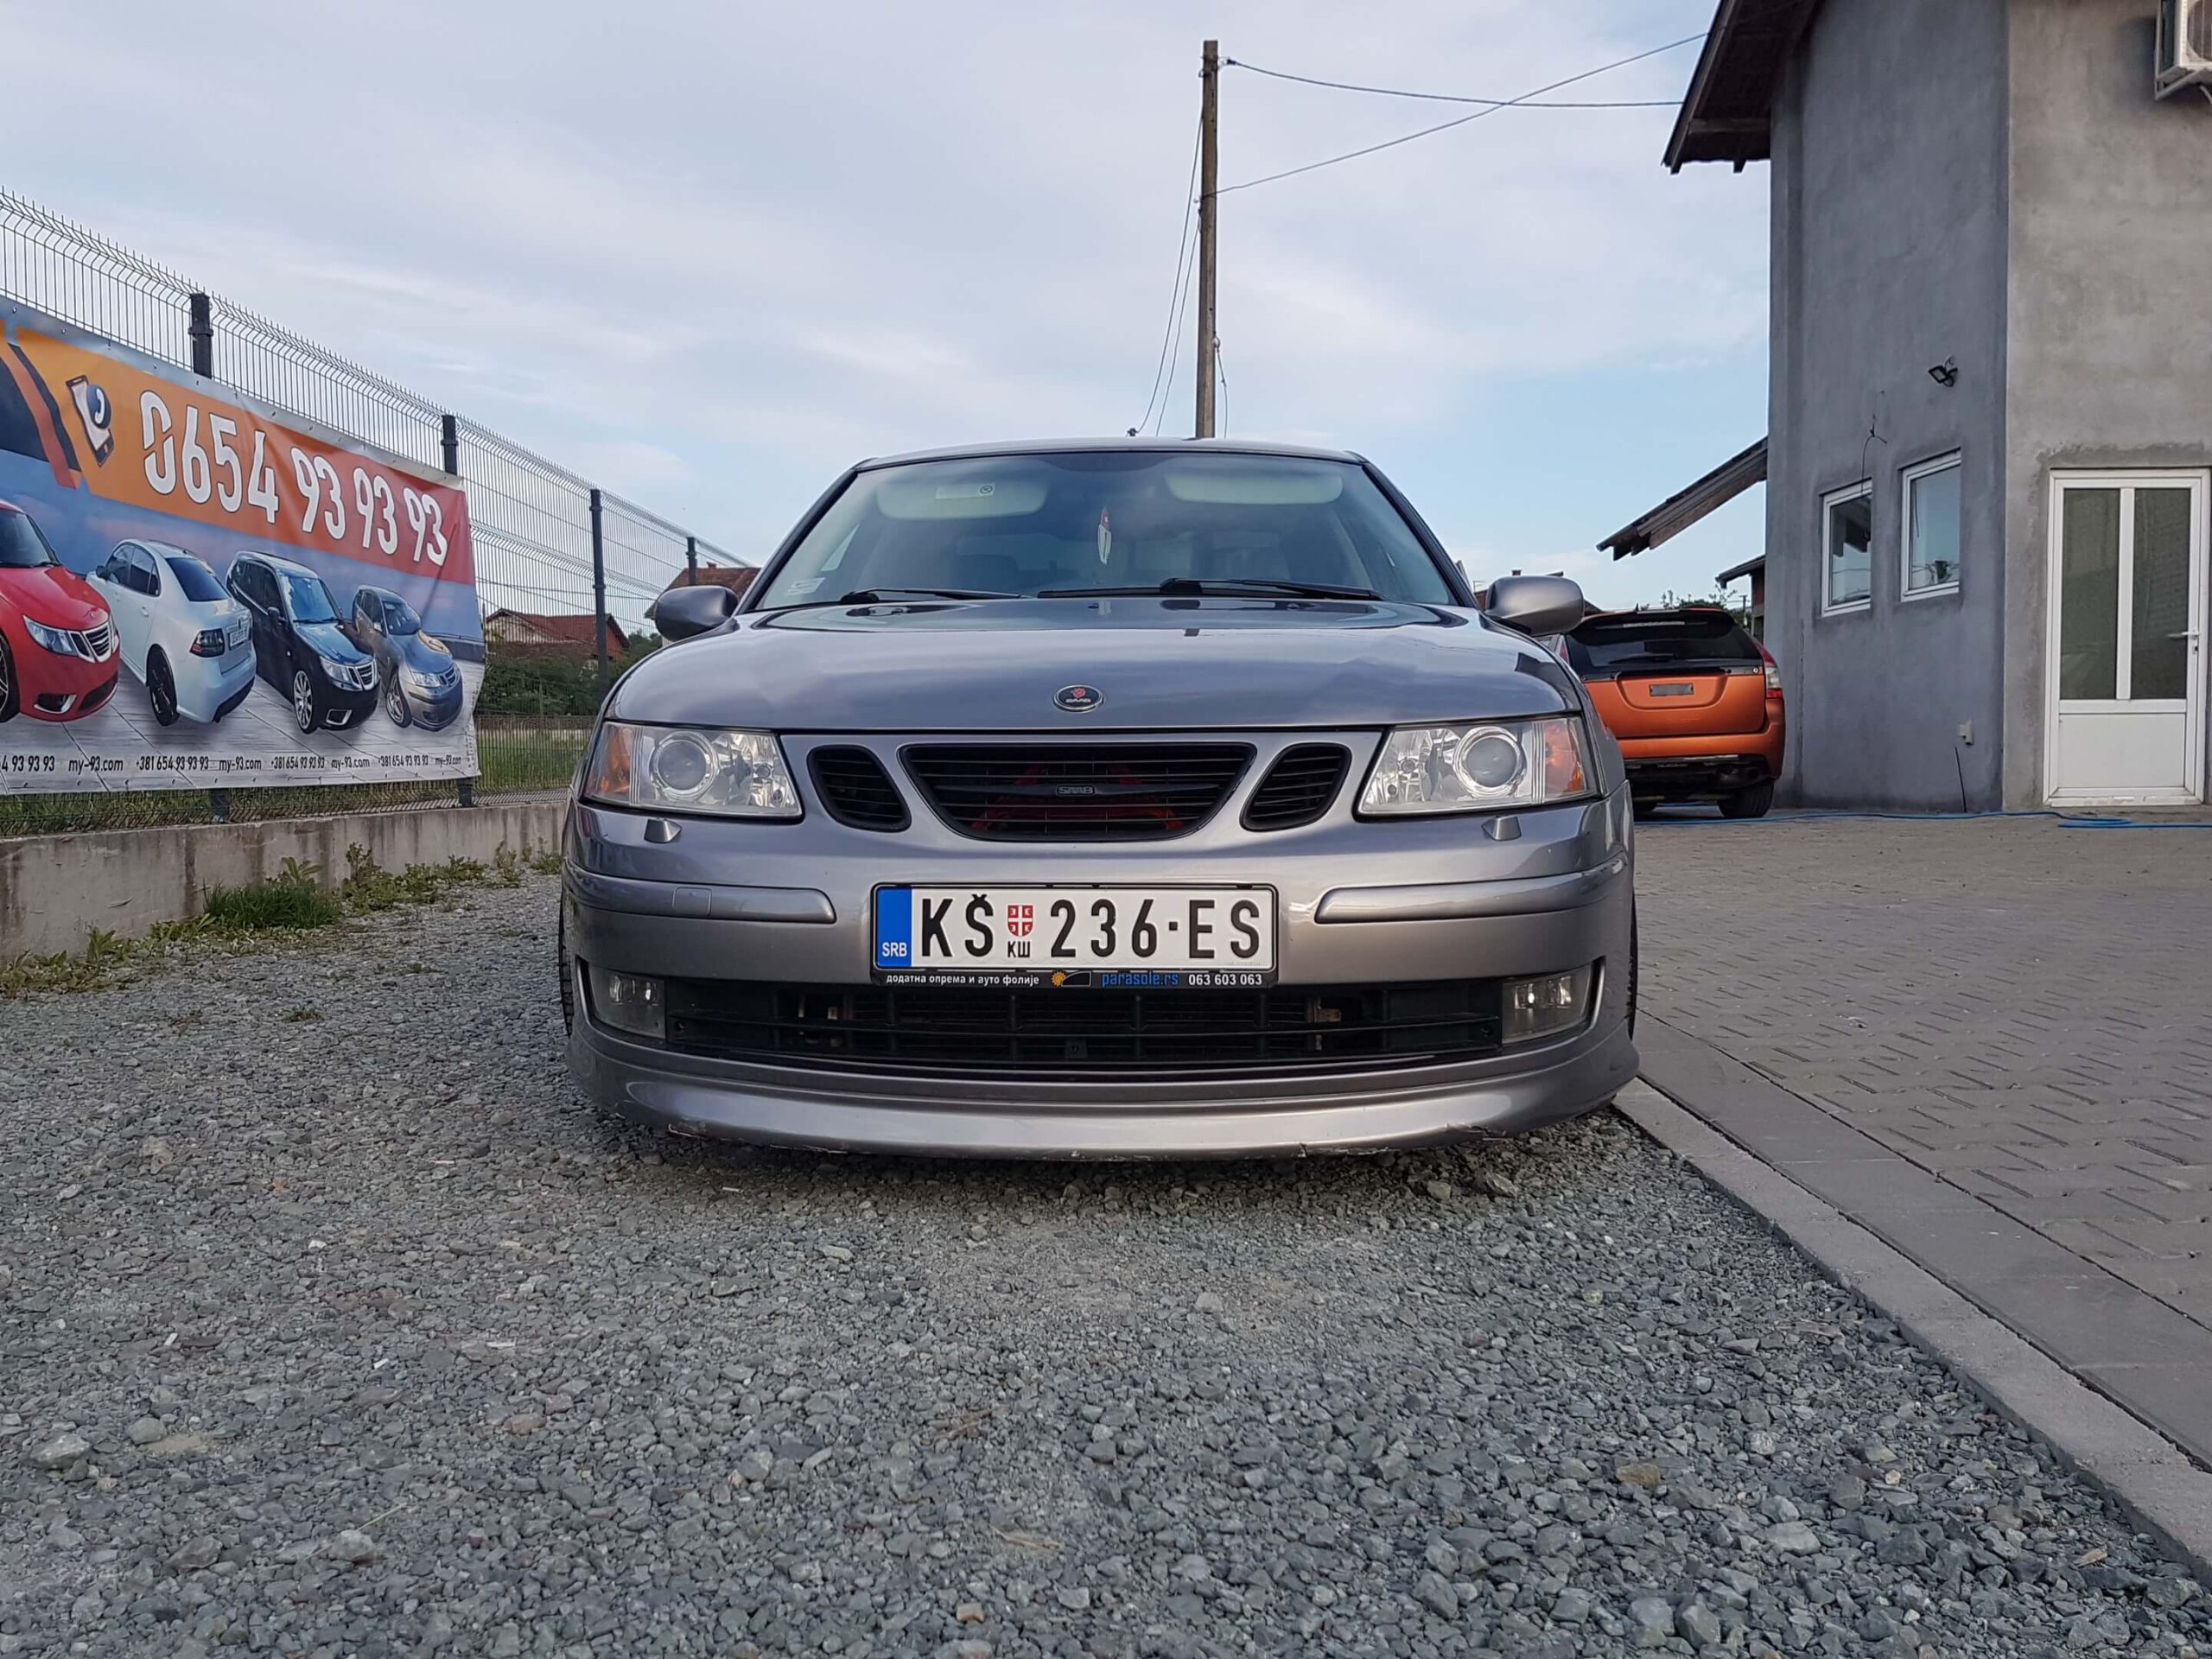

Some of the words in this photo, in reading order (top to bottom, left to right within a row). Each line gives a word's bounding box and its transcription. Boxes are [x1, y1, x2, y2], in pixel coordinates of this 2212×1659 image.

[140, 391, 278, 524] 0654
[291, 447, 346, 540] 93
[353, 467, 398, 555] 93
[404, 487, 448, 566] 93
[0, 754, 9, 772] 4
[12, 755, 24, 772] 93
[29, 755, 40, 772] 93
[43, 755, 55, 772] 93
[69, 755, 124, 775] my-93.com
[156, 756, 173, 771] 654
[176, 756, 185, 770] 93
[188, 756, 197, 770] 93
[200, 756, 209, 770] 93
[219, 756, 262, 772] my-93.com
[286, 756, 299, 769] 654
[922, 893, 994, 957] KŠ
[882, 942, 907, 957] SRB
[886, 974, 926, 983] додатна
[929, 975, 966, 987] опрема
[977, 976, 1000, 986] ауто
[1002, 975, 1039, 987] фолије
[1102, 972, 1179, 987] parasole.rs
[1188, 974, 1211, 985] 063
[1214, 974, 1236, 985] 603
[1240, 974, 1262, 985] 063
